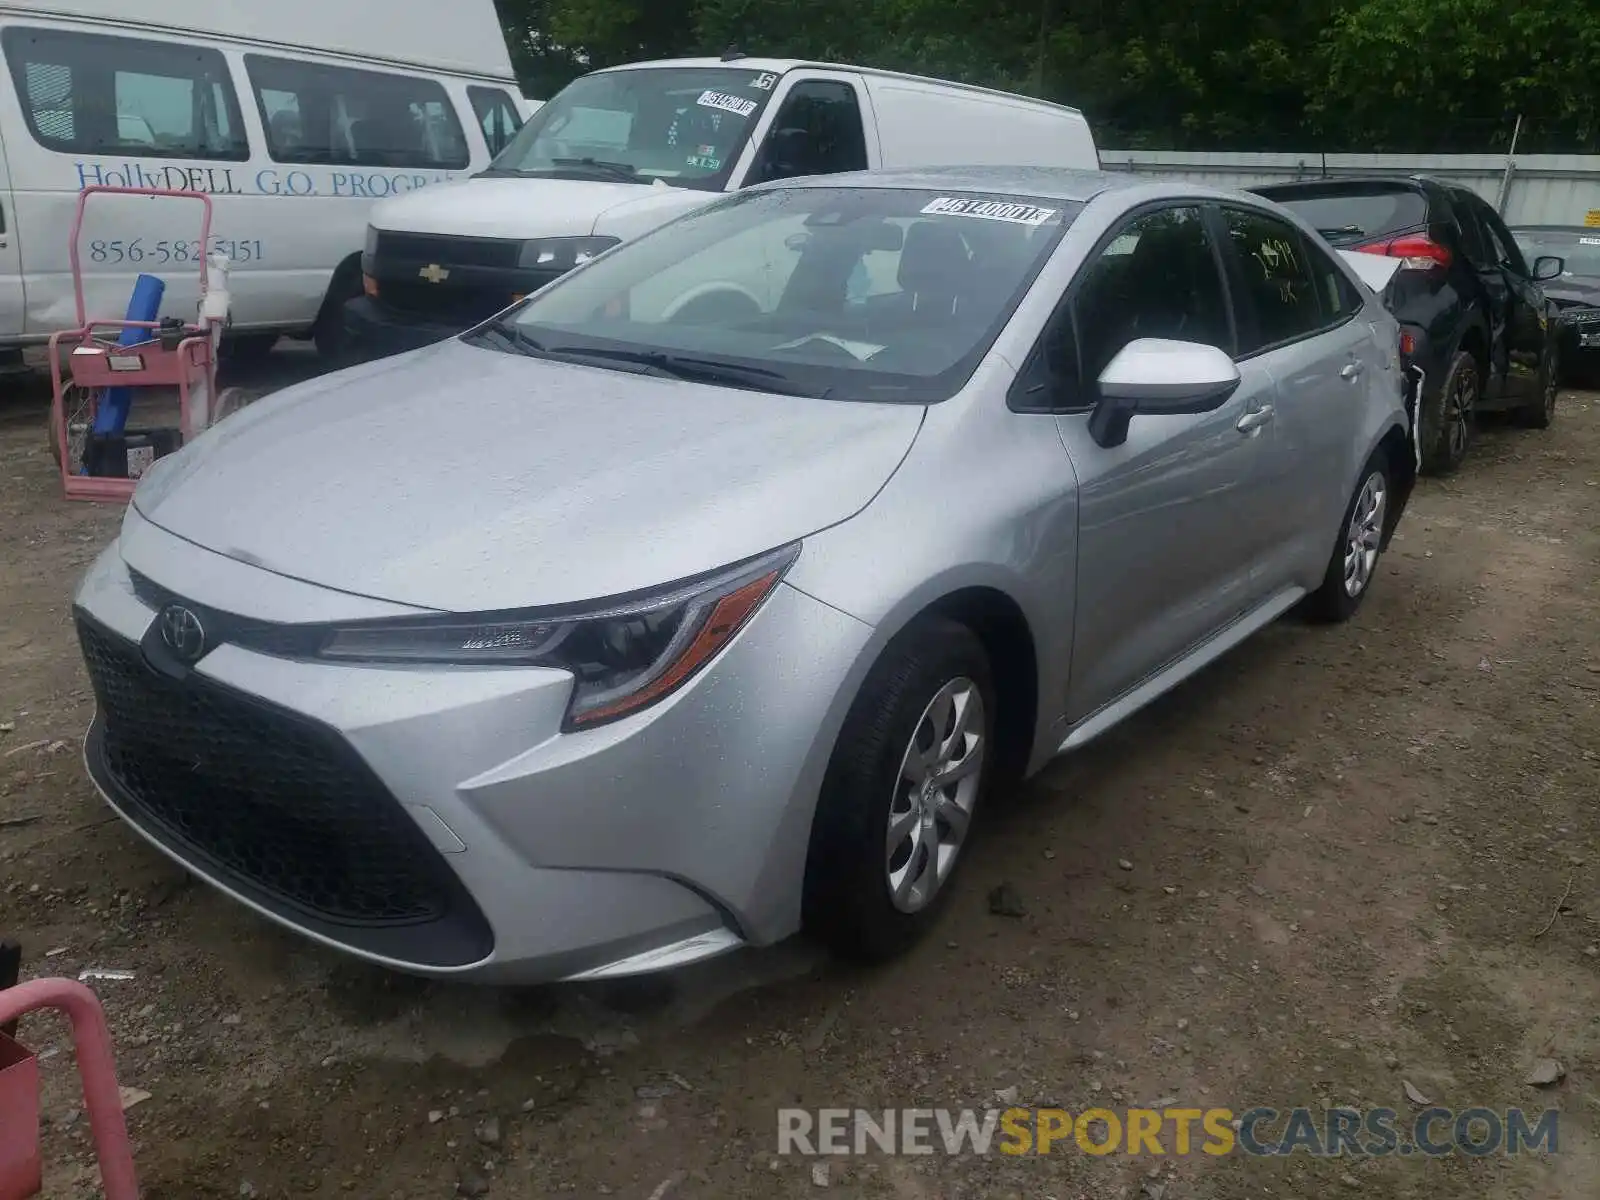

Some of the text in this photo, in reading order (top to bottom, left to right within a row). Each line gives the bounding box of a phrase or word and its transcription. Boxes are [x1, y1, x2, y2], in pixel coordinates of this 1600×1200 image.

[75, 164, 453, 198] HollyDELL G.O. PROGR
[89, 239, 264, 264] 856-582-5151
